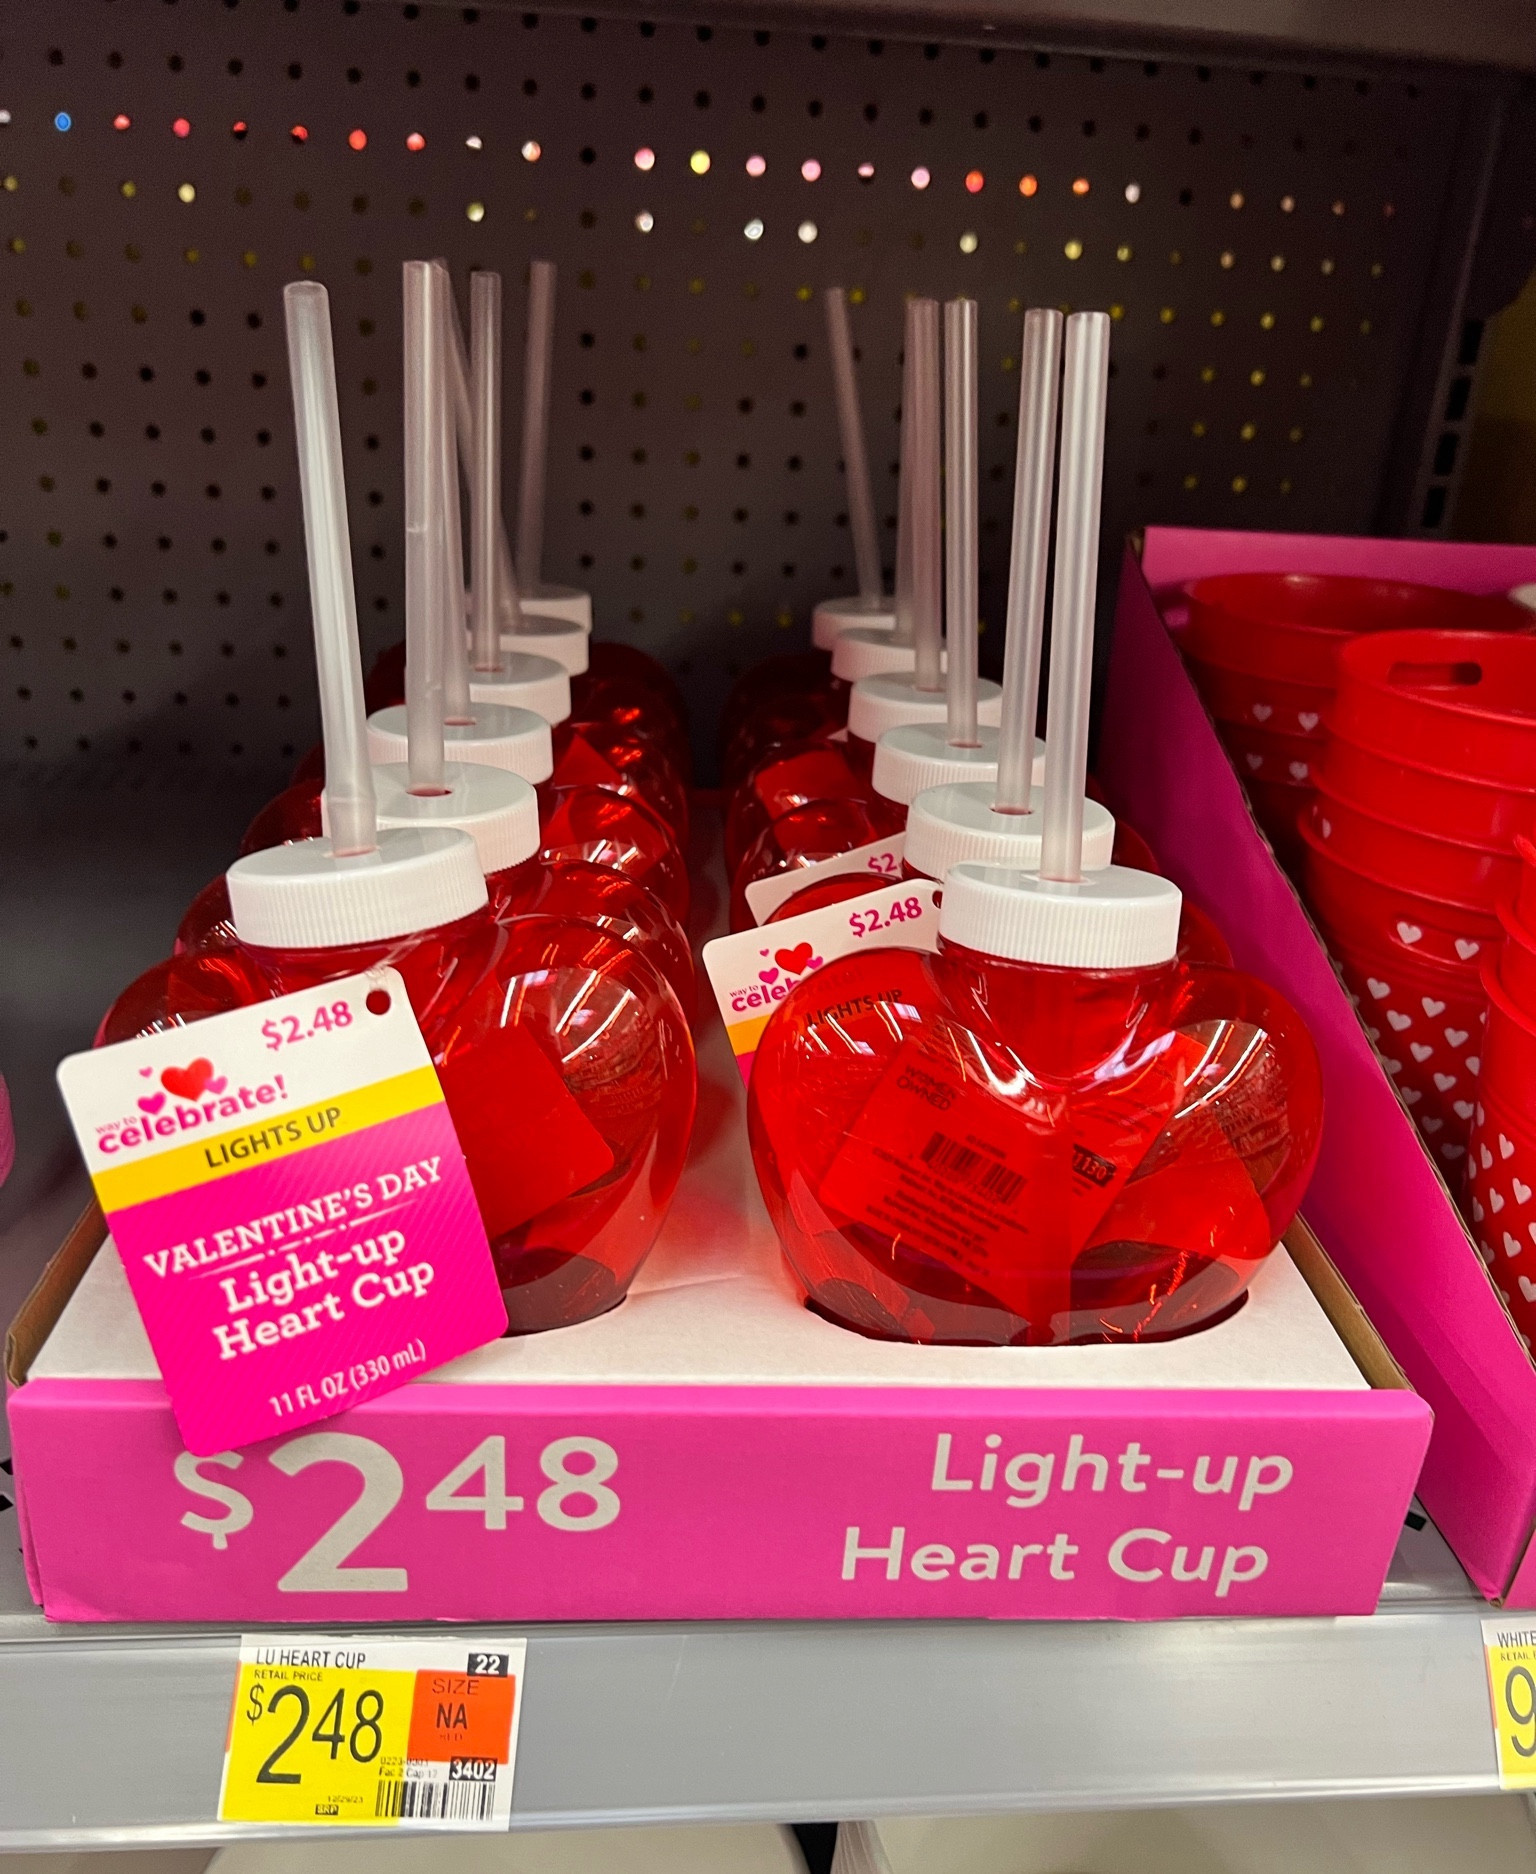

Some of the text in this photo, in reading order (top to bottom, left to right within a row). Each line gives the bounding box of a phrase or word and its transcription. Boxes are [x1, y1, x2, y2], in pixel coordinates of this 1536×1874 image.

[849, 897, 922, 937] $2.48
[729, 984, 759, 998] way to
[261, 1001, 353, 1051] $2.48
[806, 994, 875, 1026] LIGHTS
[95, 1116, 137, 1135] way to
[99, 1074, 288, 1154] celebrate!
[205, 1106, 342, 1168] LIGHTS UP
[143, 1157, 443, 1278] VALENTINE'S DAY
[219, 1229, 406, 1313] Light-up
[213, 1261, 436, 1360] Heart Cup
[269, 1337, 426, 1417] 11 FL OZ (330 mL)
[931, 1433, 1294, 1511] Light-up
[841, 1526, 1269, 1598] Heart Cup
[1497, 1631, 1536, 1649] WHITE
[256, 1648, 366, 1669] LU HEART CUP
[475, 1654, 500, 1675] 22
[1501, 1652, 1530, 1661] RETAIL
[254, 1669, 323, 1682] RETAIL PRICE
[432, 1678, 480, 1695] SIZE
[436, 1702, 468, 1730] NA
[452, 1759, 495, 1780] 3402
